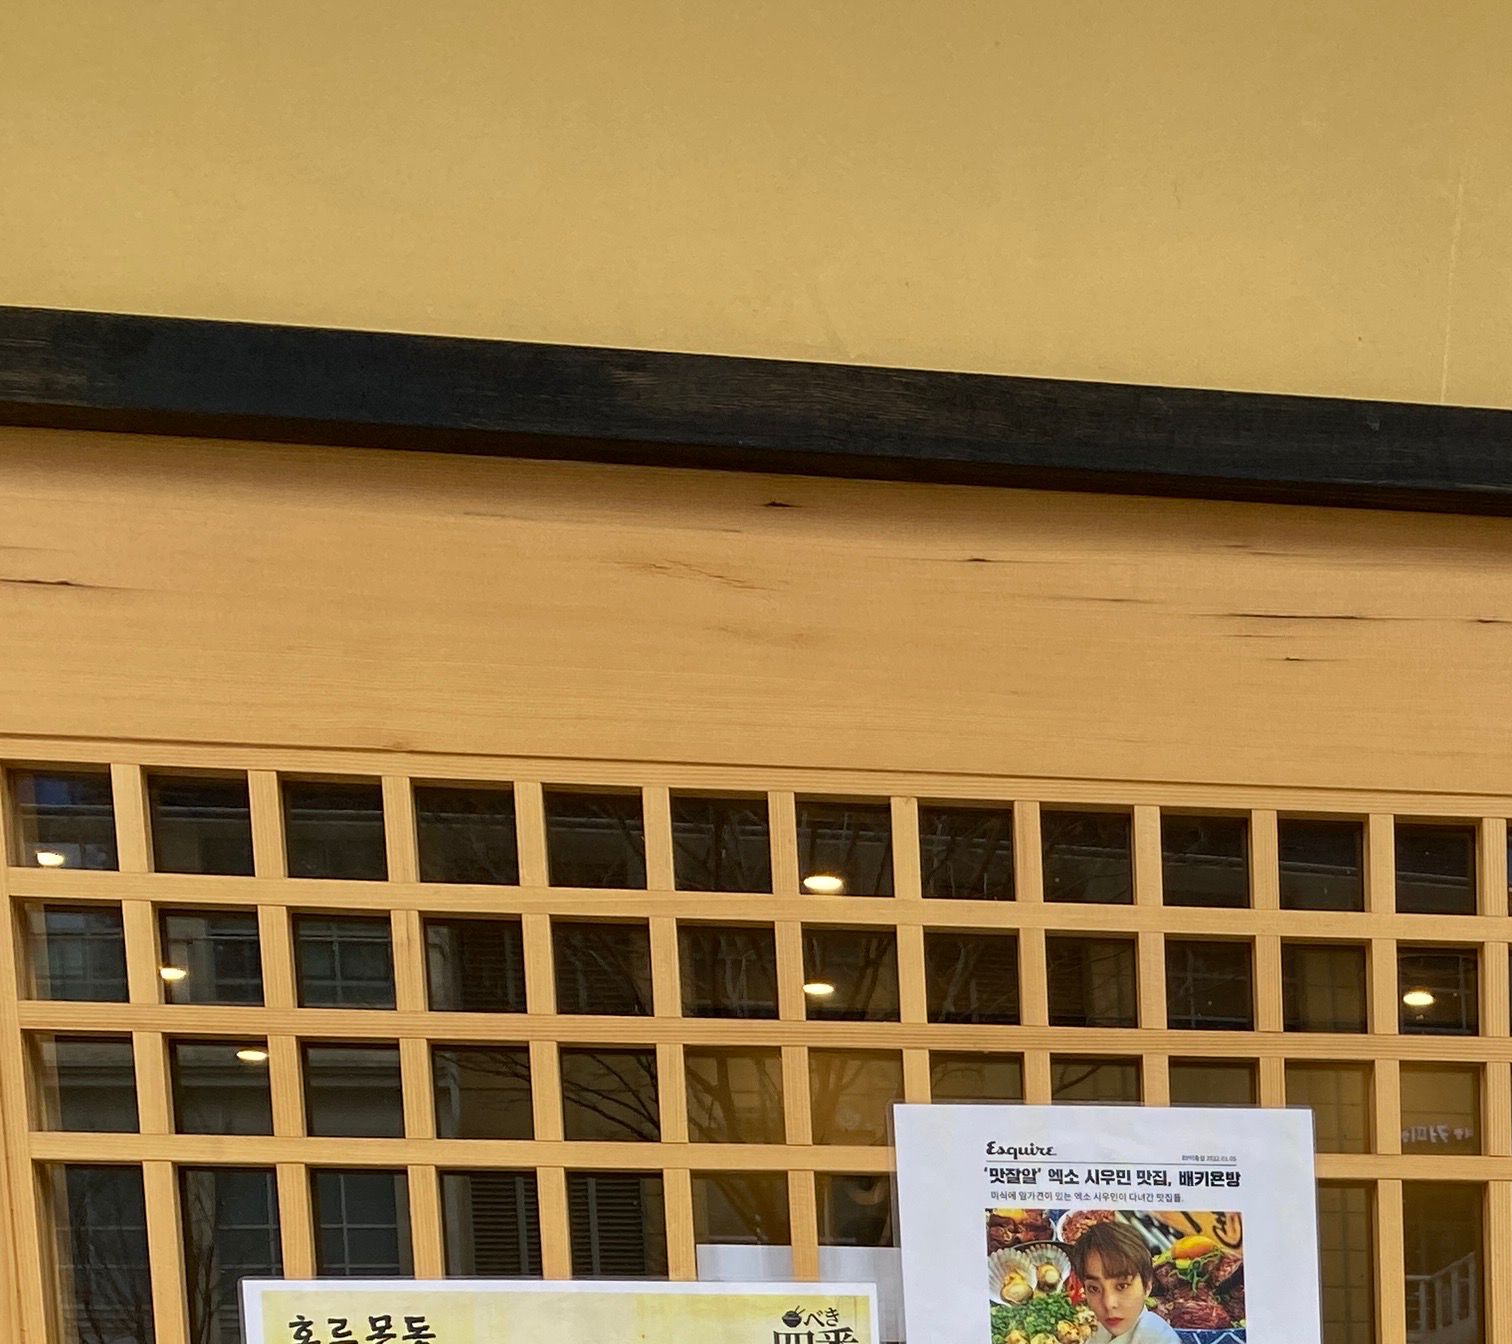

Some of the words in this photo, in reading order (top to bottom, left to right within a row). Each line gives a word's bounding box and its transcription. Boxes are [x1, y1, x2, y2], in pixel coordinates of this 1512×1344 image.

[986, 1141, 1057, 1160] Esquire
[1048, 1168, 1079, 1185] 엑소
[1085, 1169, 1131, 1186] 시우민
[1137, 1170, 1172, 1186] 맛집,
[1179, 1171, 1241, 1187] 배키욘방
